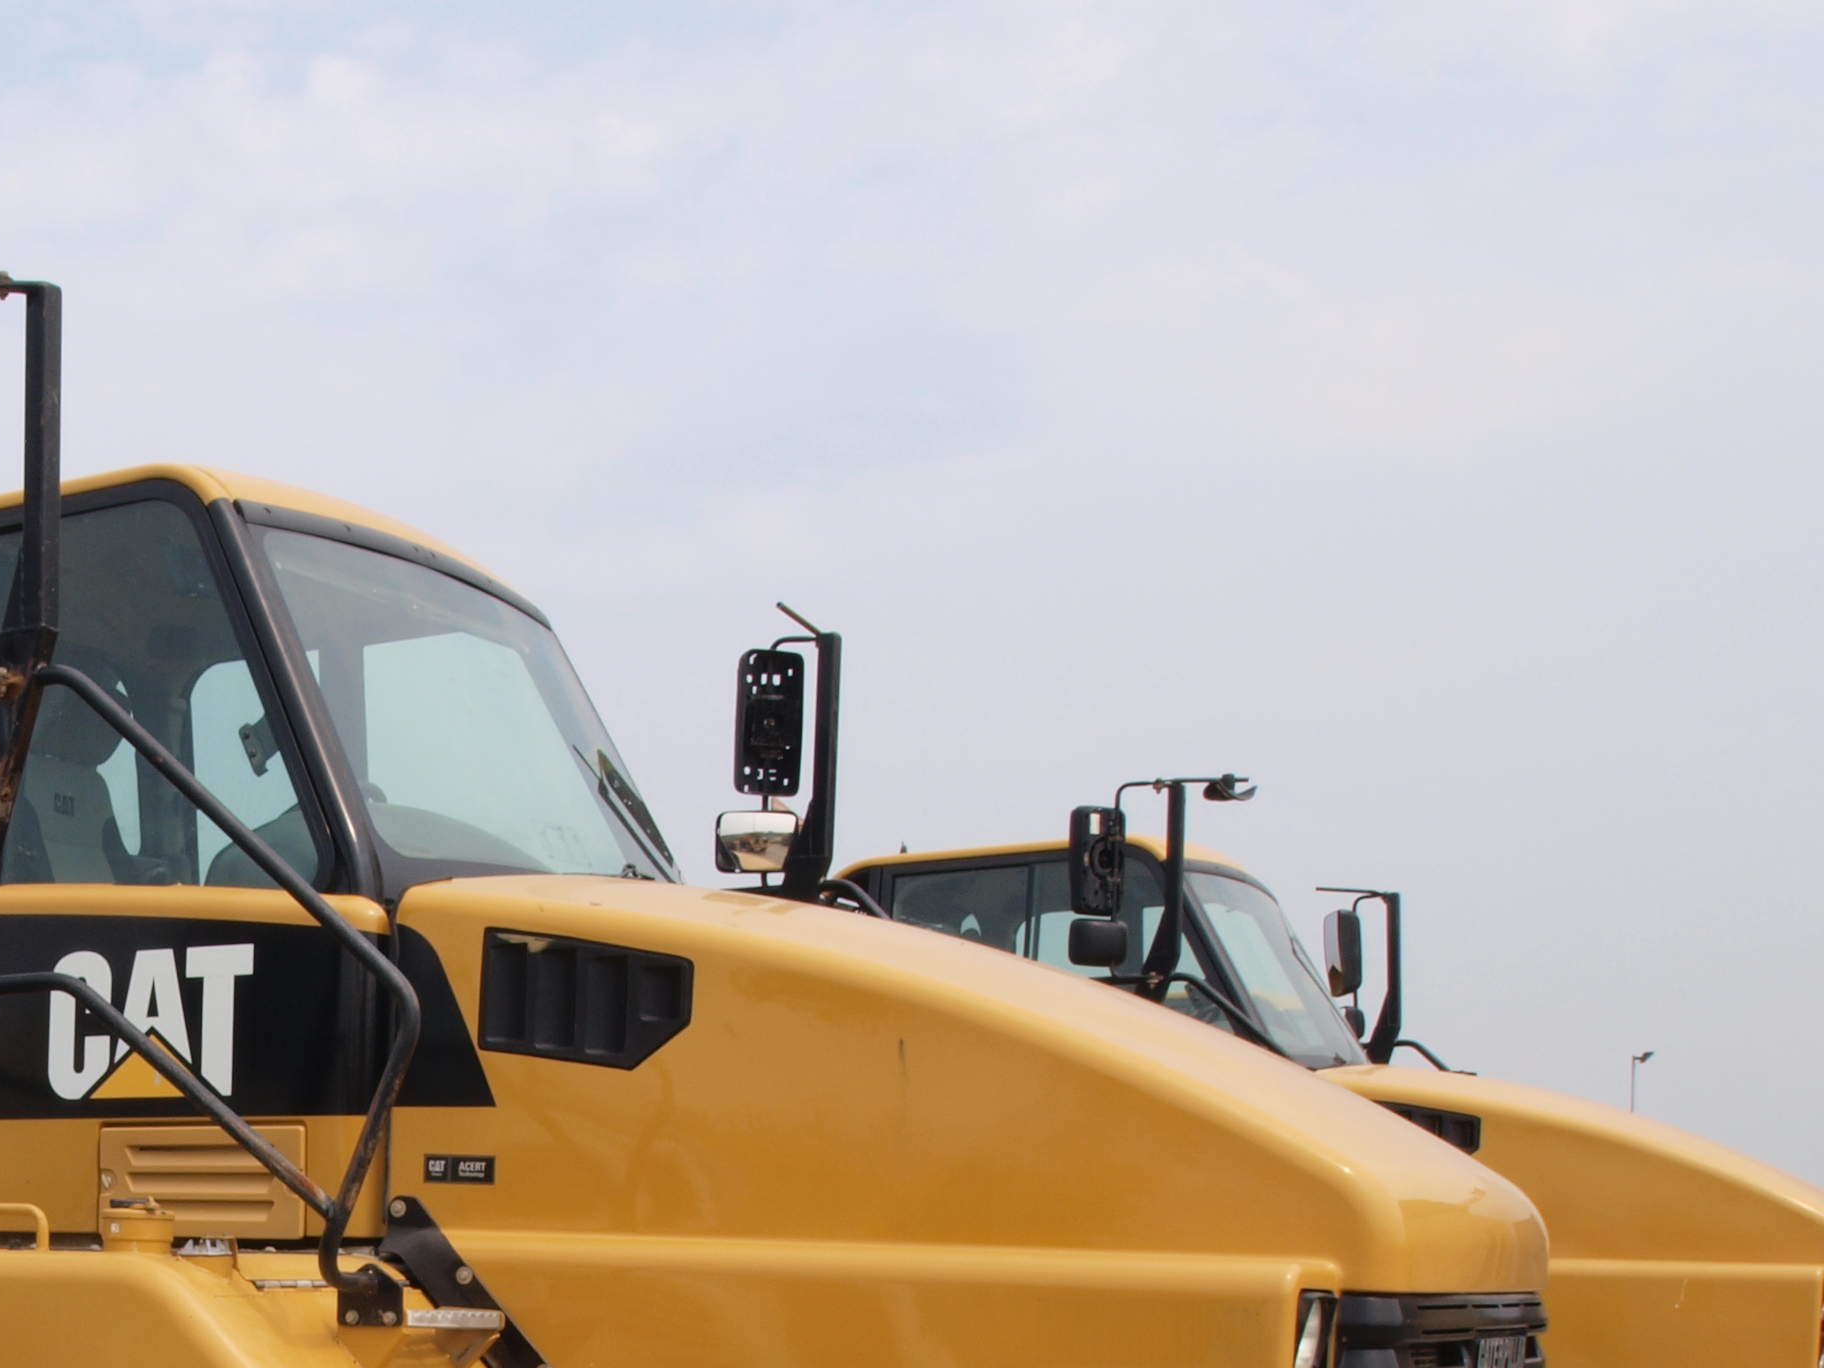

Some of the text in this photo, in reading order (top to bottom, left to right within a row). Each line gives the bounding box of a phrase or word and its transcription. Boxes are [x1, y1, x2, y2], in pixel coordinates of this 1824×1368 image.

[54, 792, 75, 817] CAT
[48, 943, 254, 1100] CAT
[428, 1159, 446, 1172] CAT
[459, 1161, 487, 1171] ACERT
